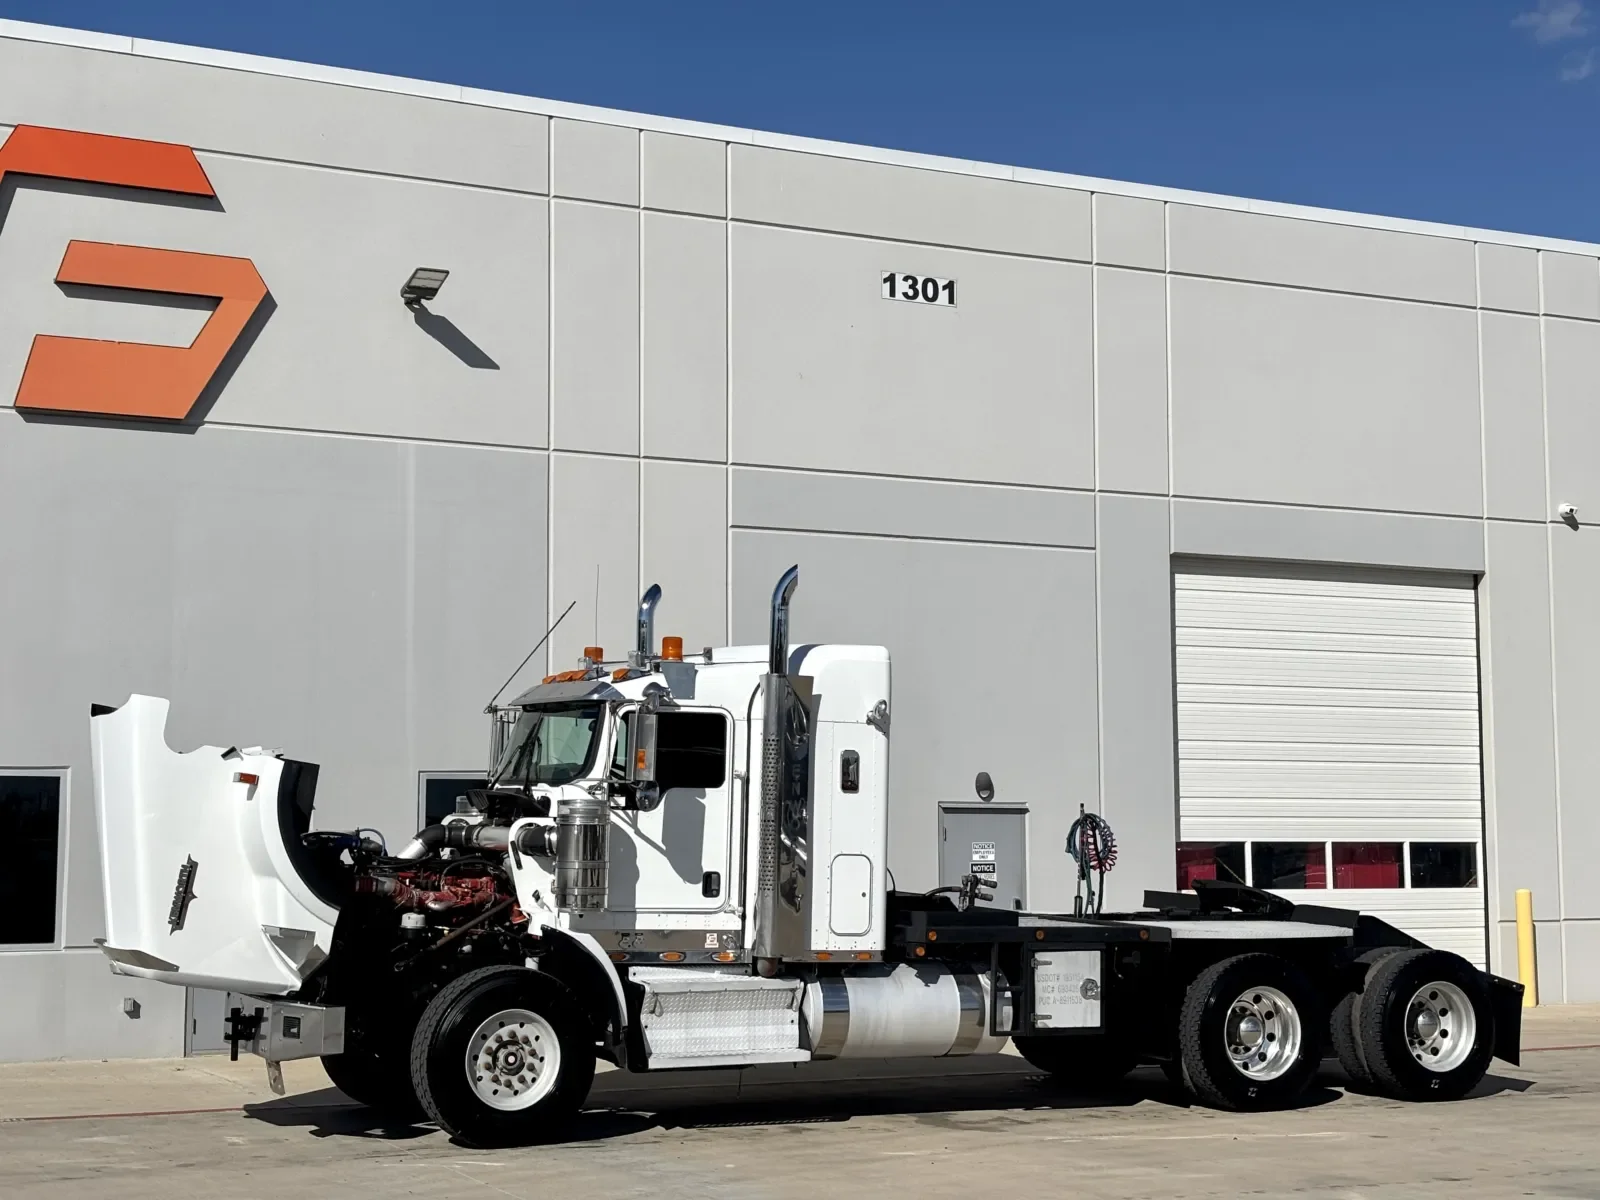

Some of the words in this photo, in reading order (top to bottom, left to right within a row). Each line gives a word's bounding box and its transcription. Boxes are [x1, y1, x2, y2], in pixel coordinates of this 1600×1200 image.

[882, 272, 955, 305] 1301
[972, 864, 994, 872] NOTICE
[167, 863, 191, 925] KENWORTH
[1036, 973, 1060, 983] USDOT#
